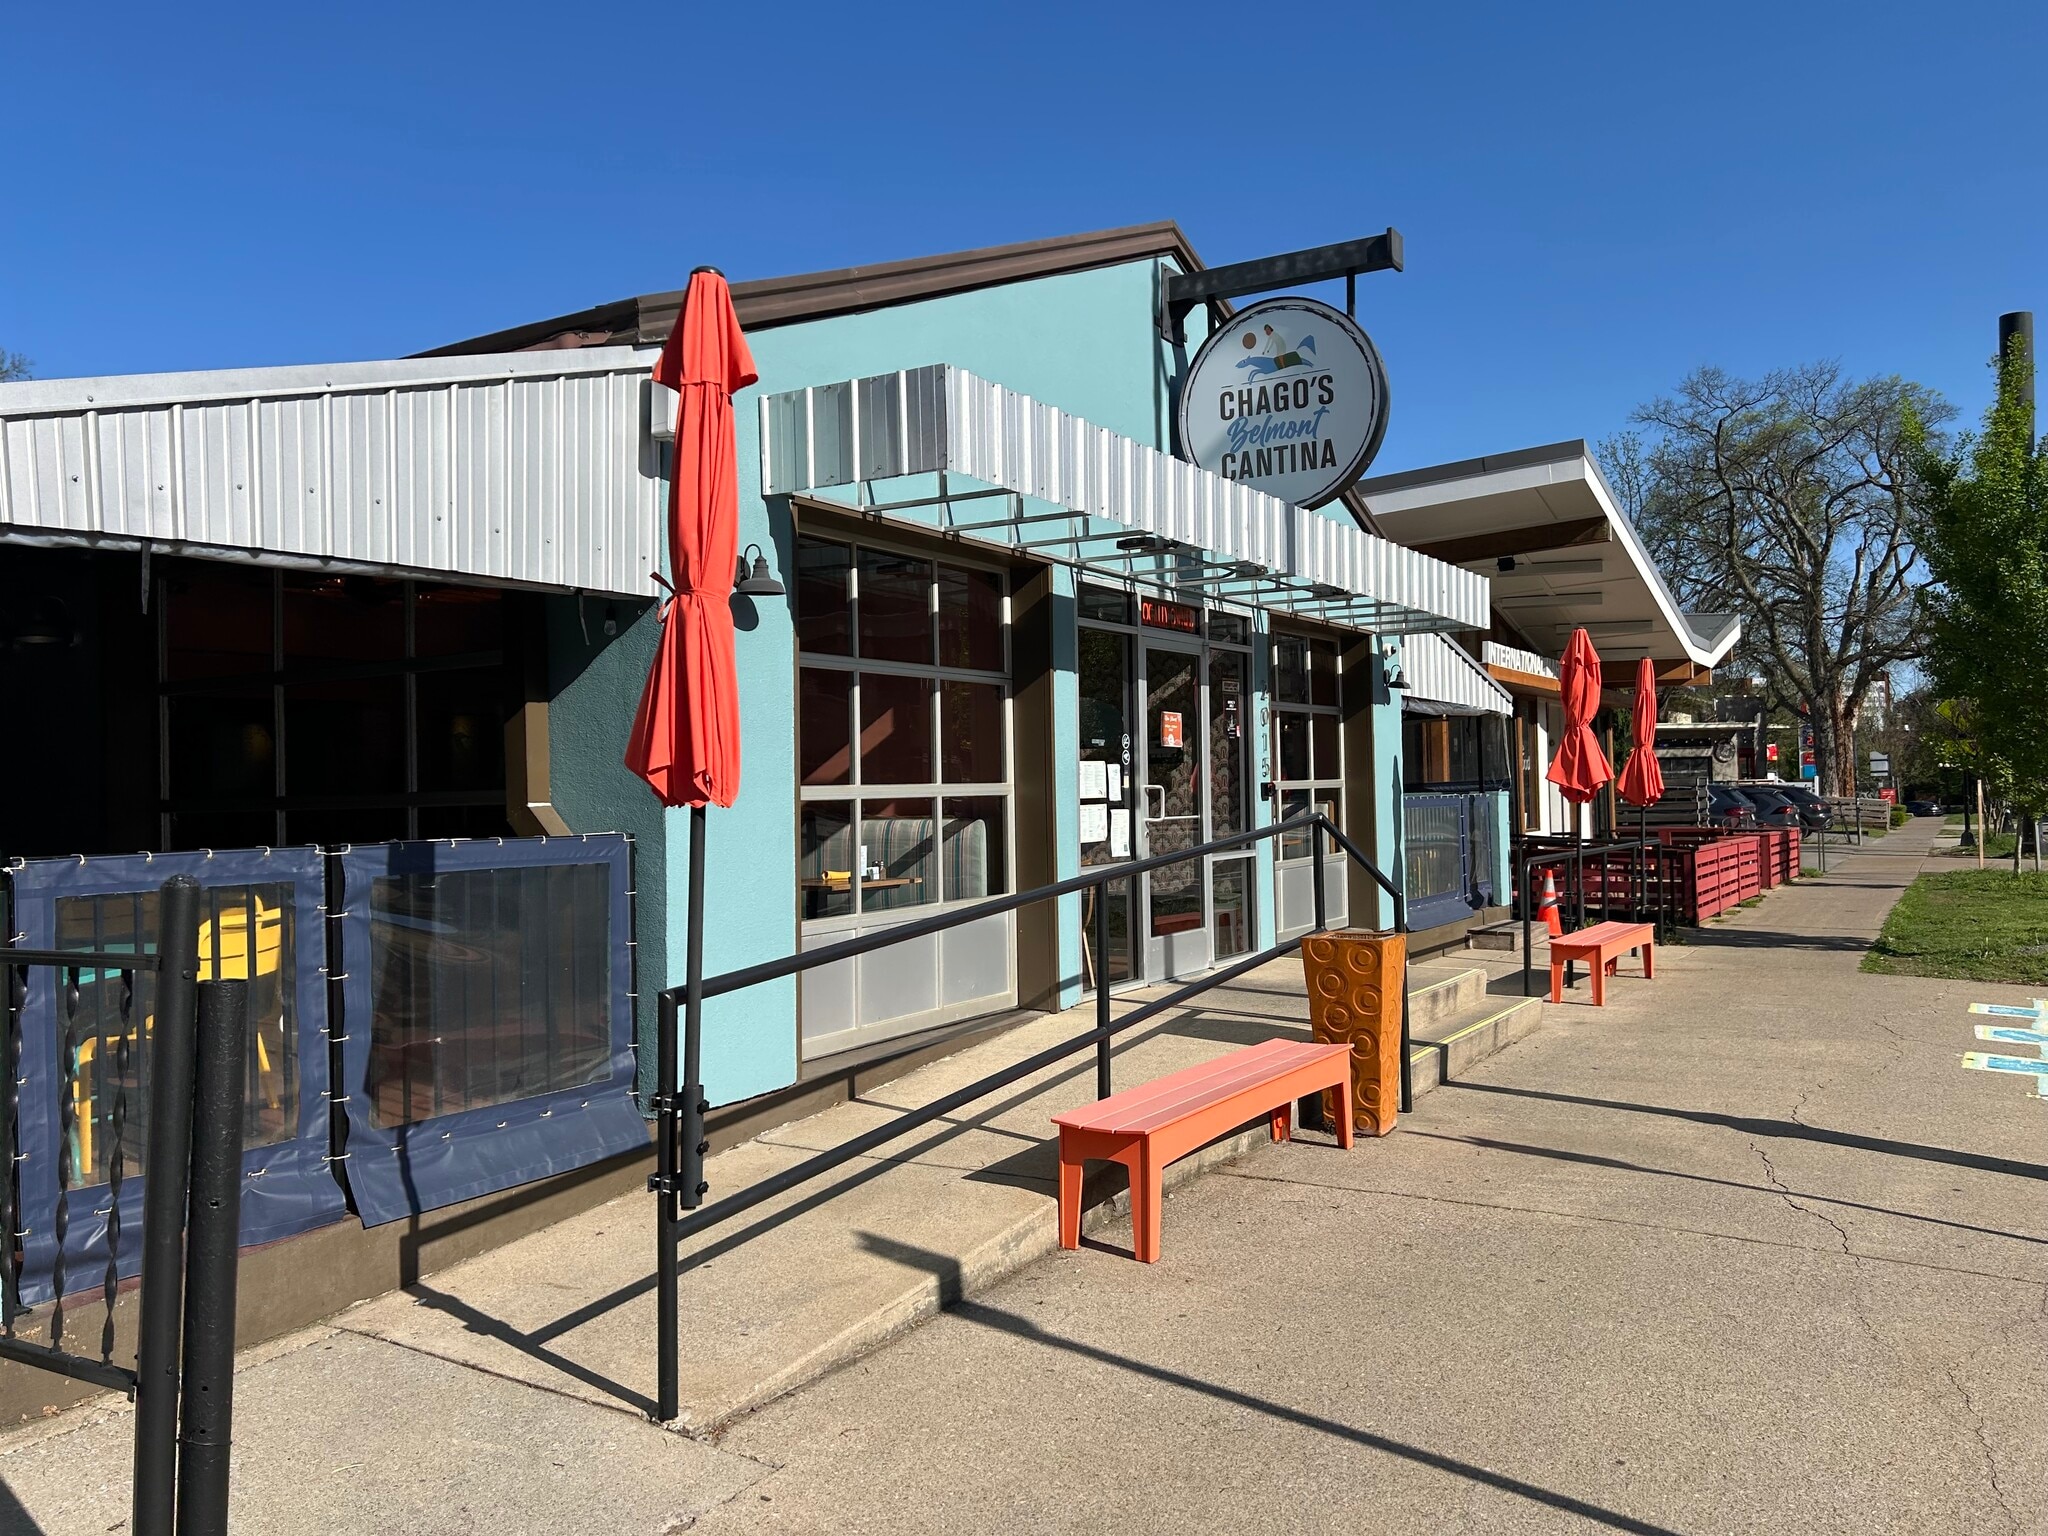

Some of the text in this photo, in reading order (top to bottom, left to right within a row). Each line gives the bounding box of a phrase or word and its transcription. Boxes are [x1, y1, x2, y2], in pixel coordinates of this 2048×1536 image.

[1219, 374, 1335, 421] CHAGO'S
[1227, 405, 1331, 453] Belmont
[1221, 438, 1338, 481] CANTINA
[1484, 640, 1547, 677] INTERNATIONAL
